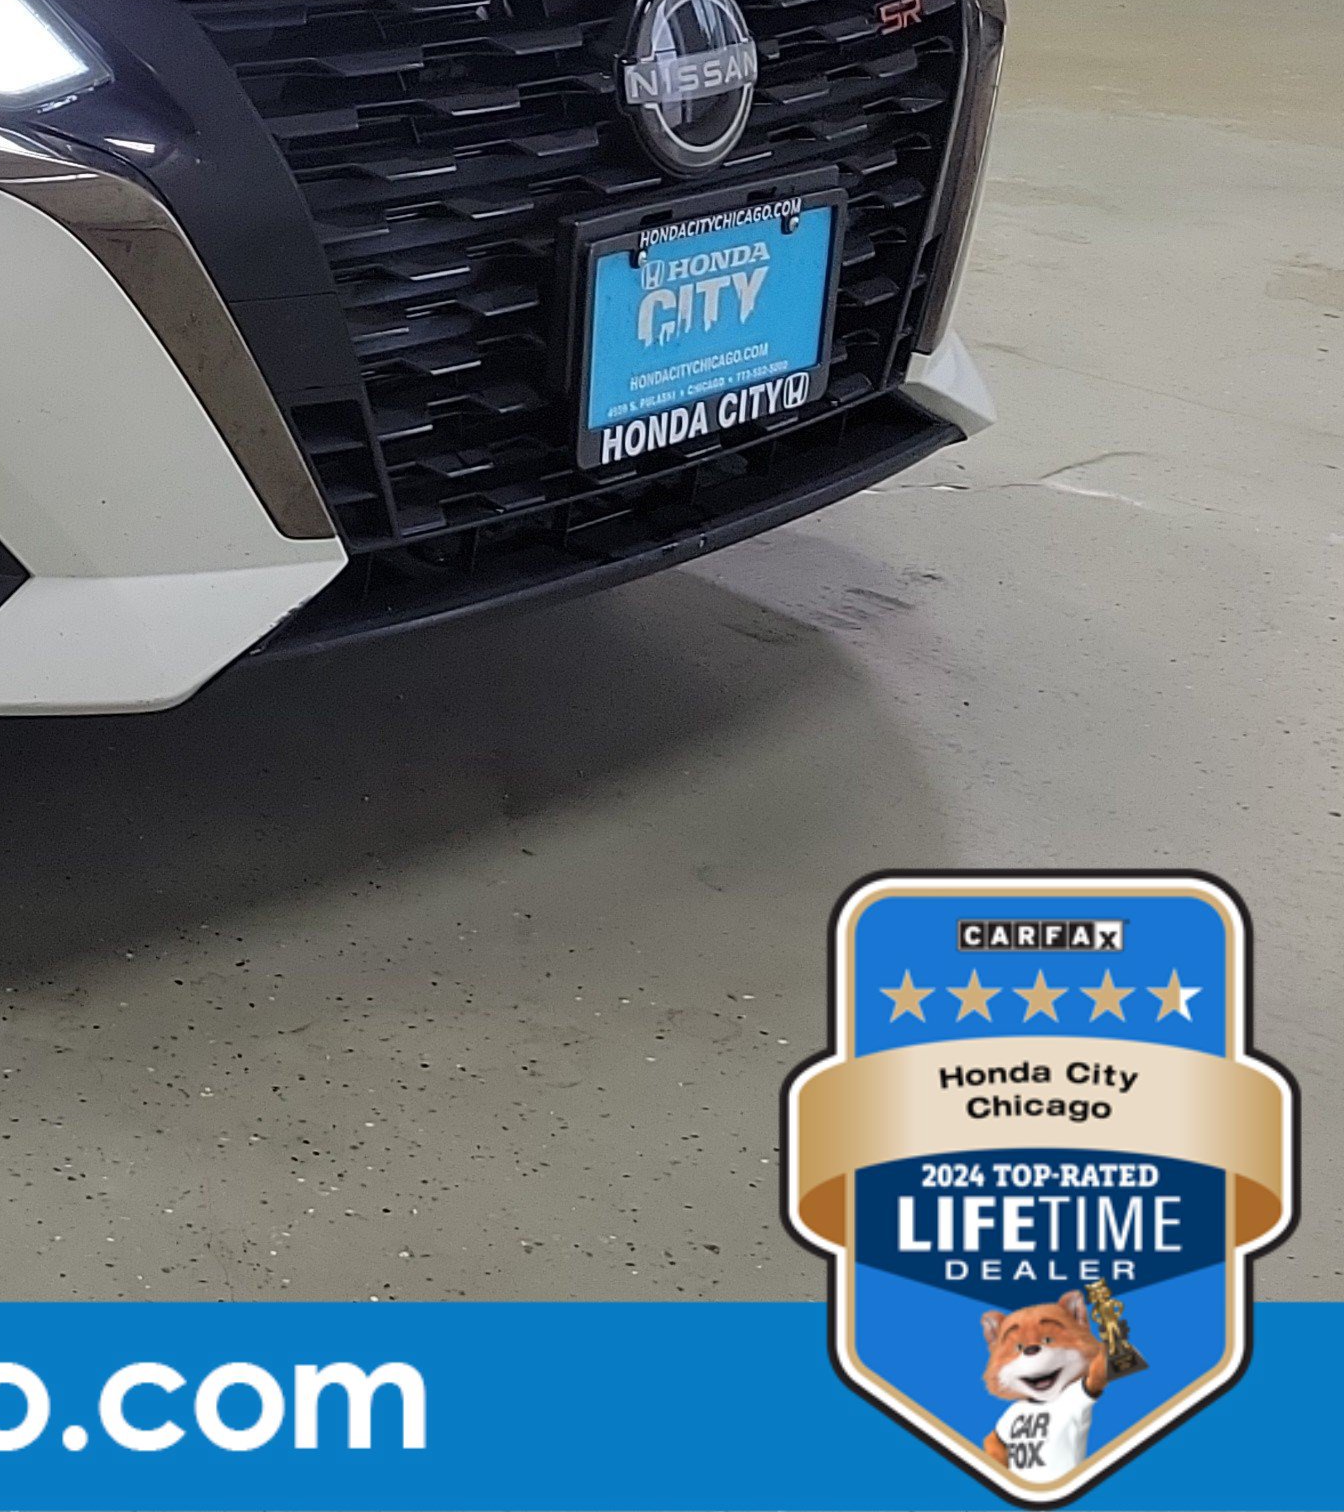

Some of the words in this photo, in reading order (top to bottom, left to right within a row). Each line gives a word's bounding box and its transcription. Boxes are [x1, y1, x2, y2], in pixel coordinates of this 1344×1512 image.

[630, 49, 757, 98] NISSAN
[639, 197, 802, 248] HONDACITYCHICAGO.COM
[667, 241, 770, 282] HONDA
[638, 265, 770, 347] CITY
[630, 342, 770, 391] HONDACITYCHICAGO.COM
[601, 401, 709, 465] HONDA
[718, 377, 784, 429] CITY
